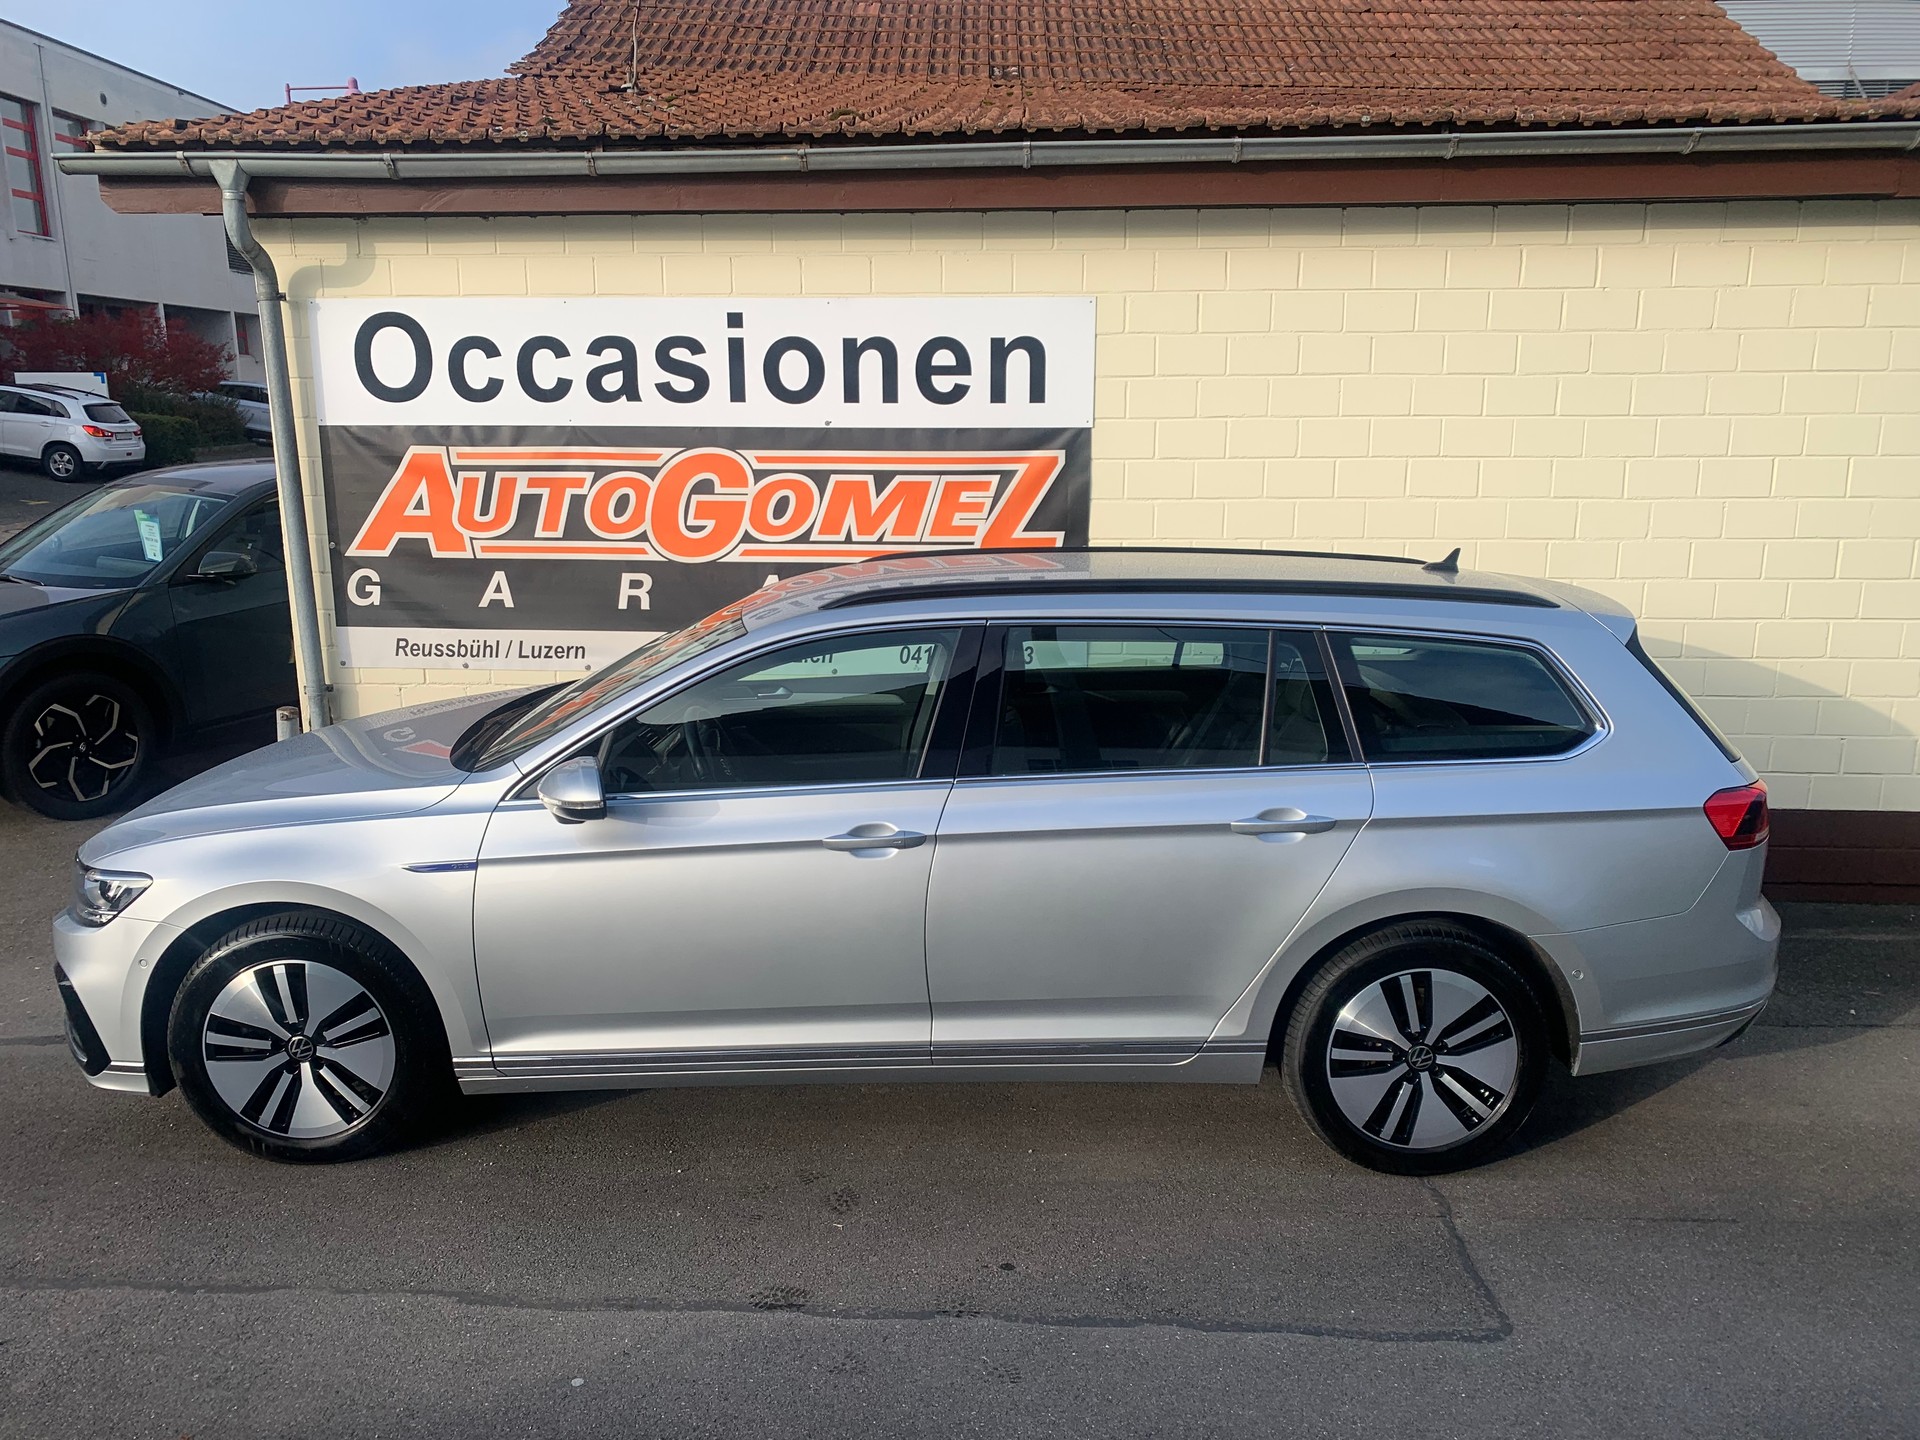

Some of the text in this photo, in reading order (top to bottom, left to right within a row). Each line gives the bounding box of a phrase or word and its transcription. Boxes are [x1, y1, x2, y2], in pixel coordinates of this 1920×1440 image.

[354, 311, 1046, 404] Occasionen
[395, 637, 586, 659] Reussbühl / Luzern
